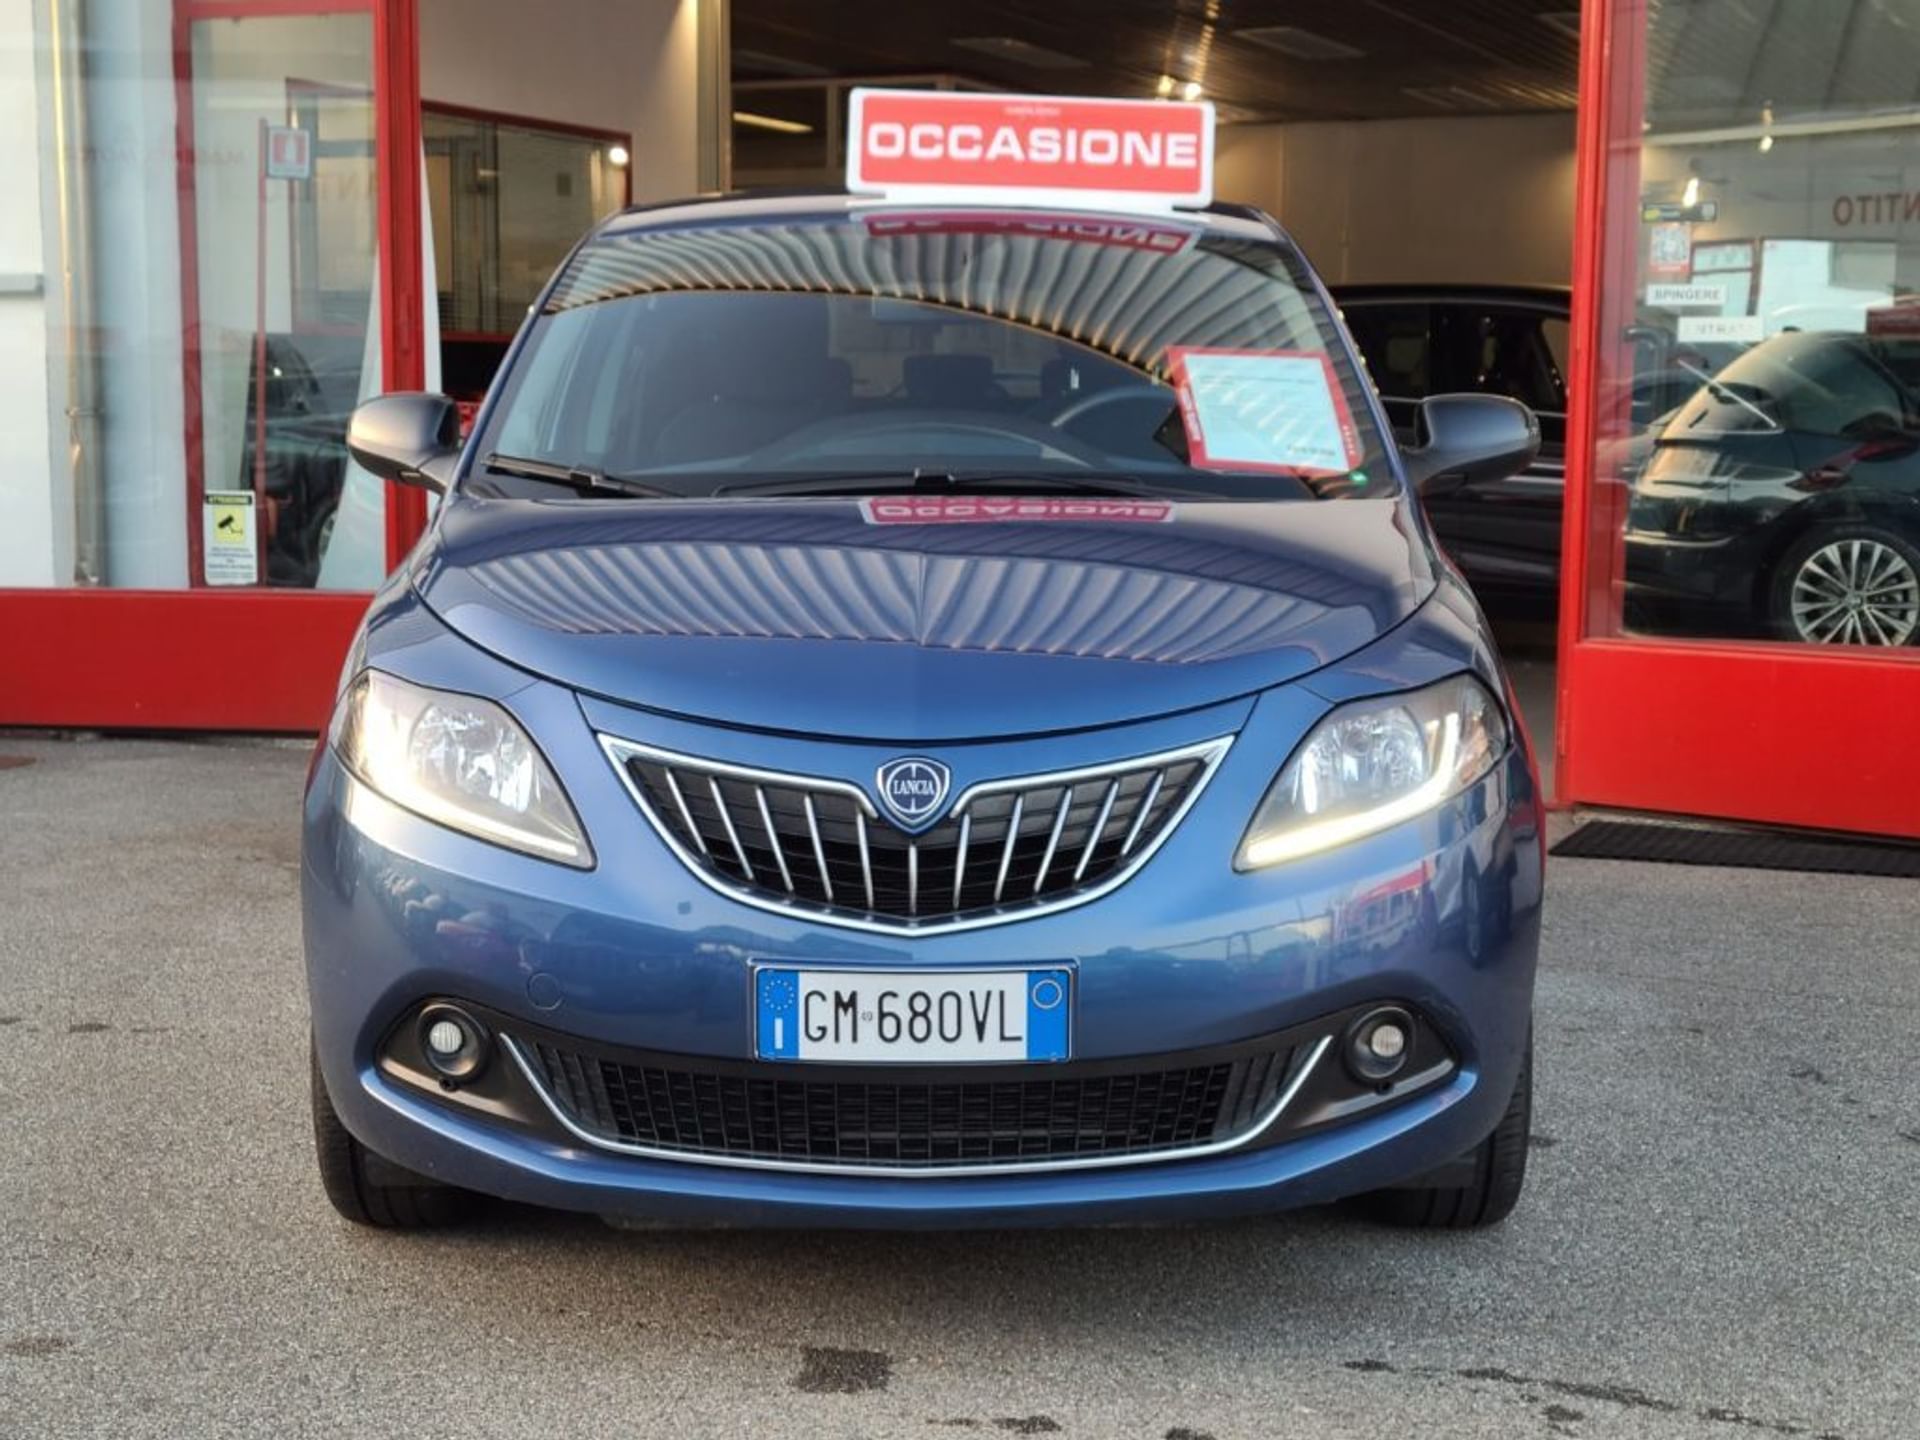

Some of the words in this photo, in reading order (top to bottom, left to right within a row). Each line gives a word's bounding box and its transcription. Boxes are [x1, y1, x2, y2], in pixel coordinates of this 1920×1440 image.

[867, 122, 1198, 169] OCCASIONE
[1653, 288, 1721, 301] SPINGERE
[893, 779, 935, 795] LANCIA
